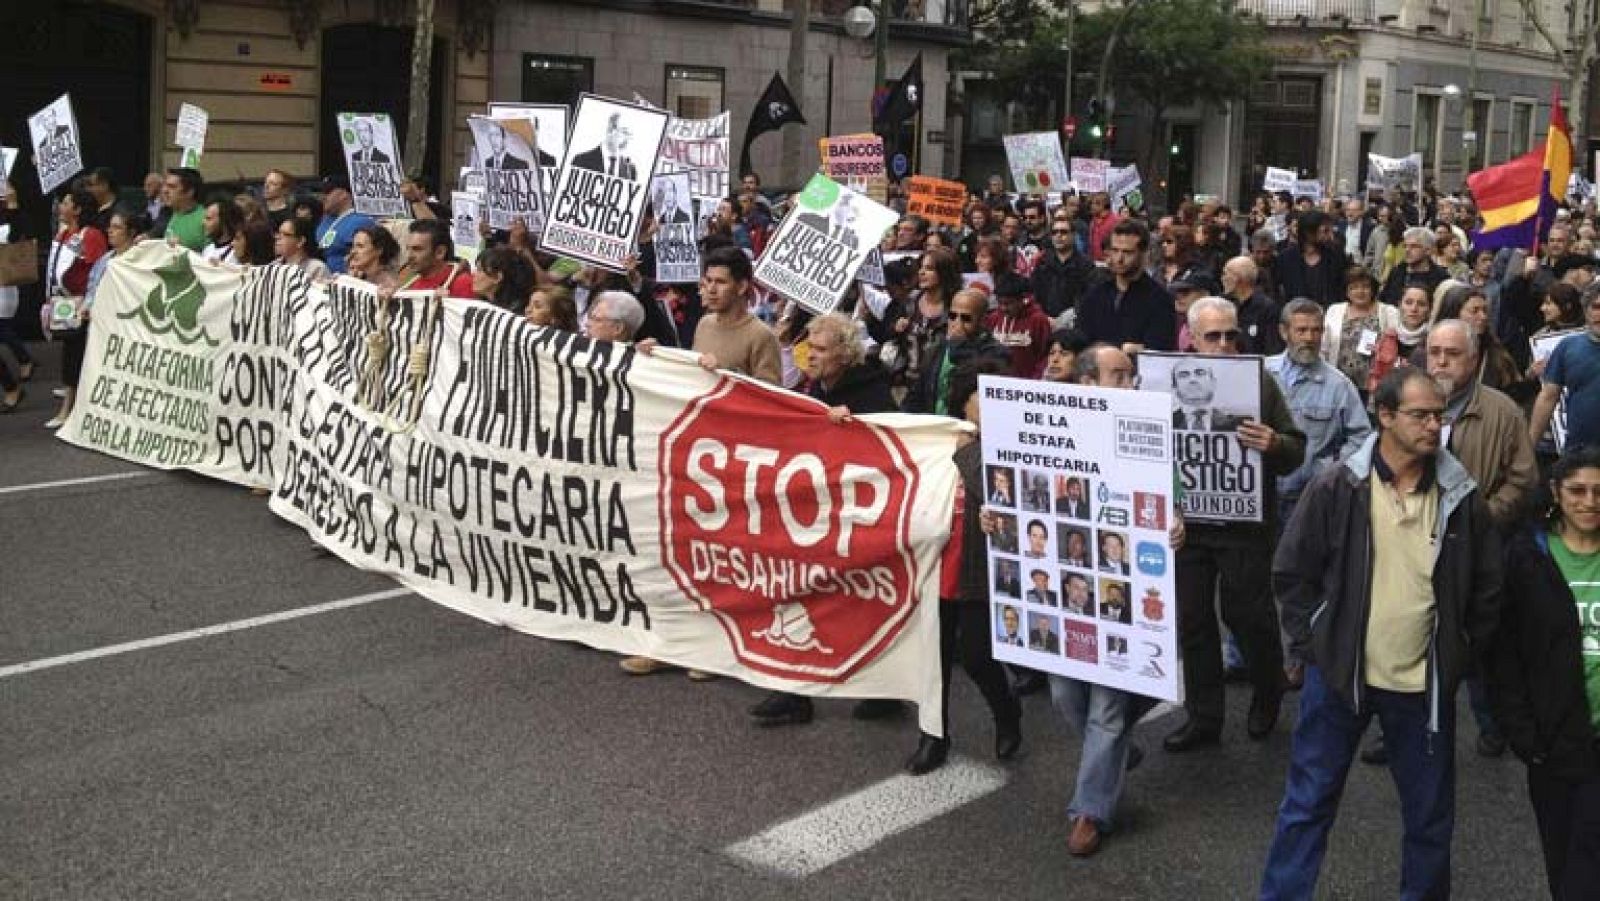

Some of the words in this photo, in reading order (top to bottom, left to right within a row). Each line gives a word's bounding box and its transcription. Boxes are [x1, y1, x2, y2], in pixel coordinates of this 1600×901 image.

[828, 144, 883, 157] BANCOS
[555, 190, 633, 239] CASTIGO
[562, 168, 623, 208] JUICIO
[626, 182, 641, 215] Y
[771, 235, 849, 293] CASTIGO
[784, 222, 845, 267] JUICIO
[104, 333, 213, 393] PLATAFORMA
[90, 373, 111, 408] DE
[115, 383, 209, 436] AFECTADOS
[440, 306, 638, 472] FINANCIERA
[985, 386, 1109, 412] RESPONSABLES
[80, 412, 111, 449] POR
[112, 426, 130, 453] LA
[1018, 431, 1077, 450] ESTAFA
[1024, 412, 1043, 426] DE
[1048, 414, 1069, 429] LA
[997, 450, 1101, 475] HIPOTECARIA
[1173, 433, 1229, 463] ICIO
[313, 402, 393, 496] ESTAFA
[406, 437, 636, 557] HIPOTECARIA
[684, 437, 891, 557] STOP
[1180, 461, 1256, 494] STIGO
[216, 417, 275, 478] POR
[278, 440, 378, 555] DERECHO
[385, 503, 404, 568] A
[410, 511, 454, 586] LA
[454, 525, 652, 631] VIVIENDA
[690, 540, 898, 606] DESAHUCIOS
[1576, 602, 1600, 627] TO
